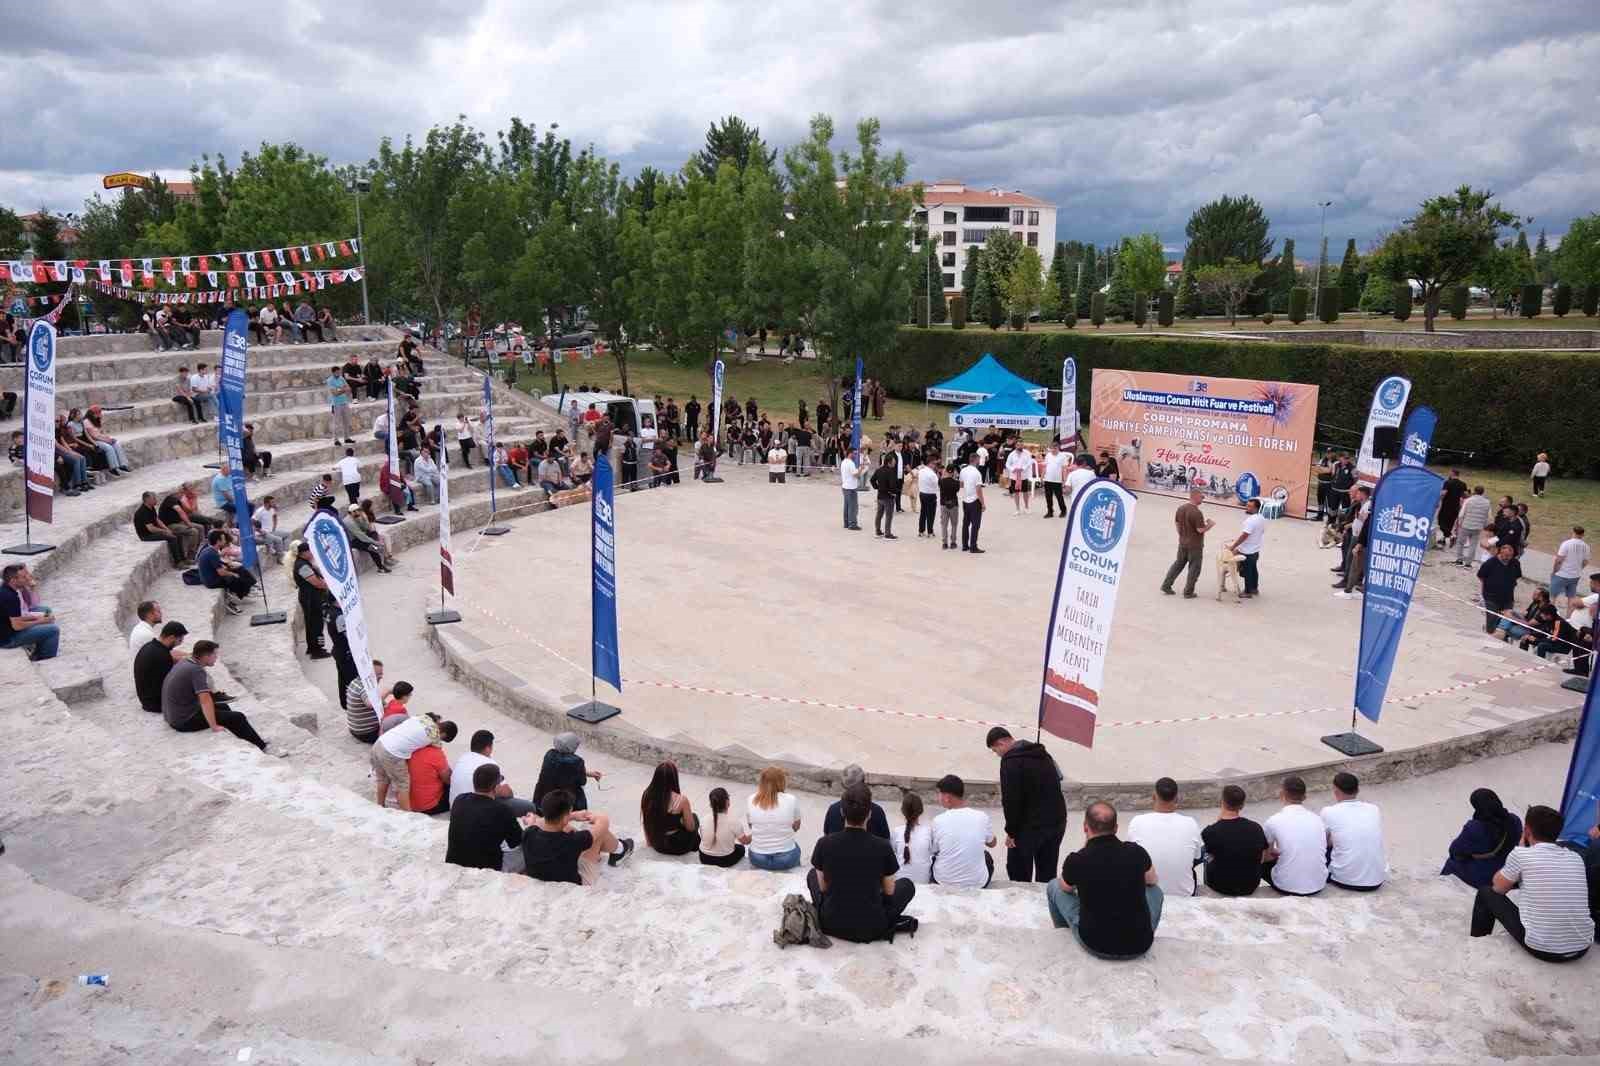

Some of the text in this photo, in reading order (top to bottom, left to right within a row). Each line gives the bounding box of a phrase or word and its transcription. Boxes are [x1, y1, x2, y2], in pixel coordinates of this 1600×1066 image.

[1209, 398, 1227, 409] Fuar
[1228, 401, 1238, 411] ve
[1238, 400, 1274, 415] Festivali
[1186, 416, 1248, 432] PROMAMA
[1212, 433, 1224, 444] ve
[1183, 451, 1232, 469] Geldiniz
[1401, 512, 1430, 541] 38
[1071, 546, 1119, 573] ÇORUM
[1068, 560, 1117, 586] BELEDİYESİ
[1057, 623, 1104, 657] MEDENİYET
